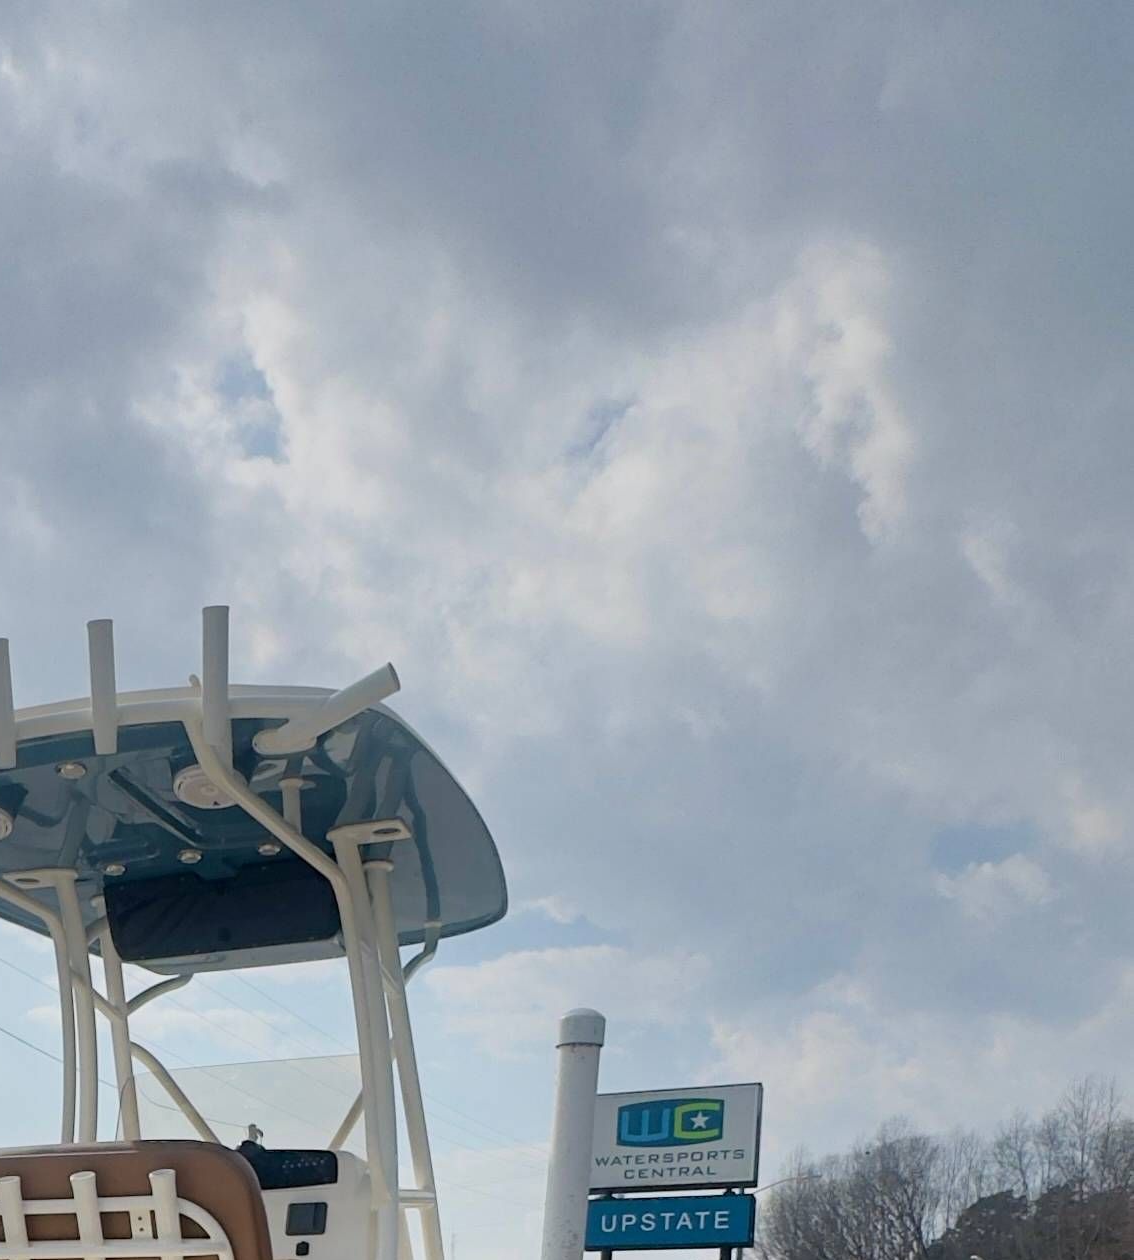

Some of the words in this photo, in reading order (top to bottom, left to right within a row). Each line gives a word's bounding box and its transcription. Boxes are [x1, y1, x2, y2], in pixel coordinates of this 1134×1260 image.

[595, 1149, 745, 1167] WATERSPORTS
[624, 1166, 717, 1180] CENTRAL
[601, 1211, 730, 1233] UPSTATE
